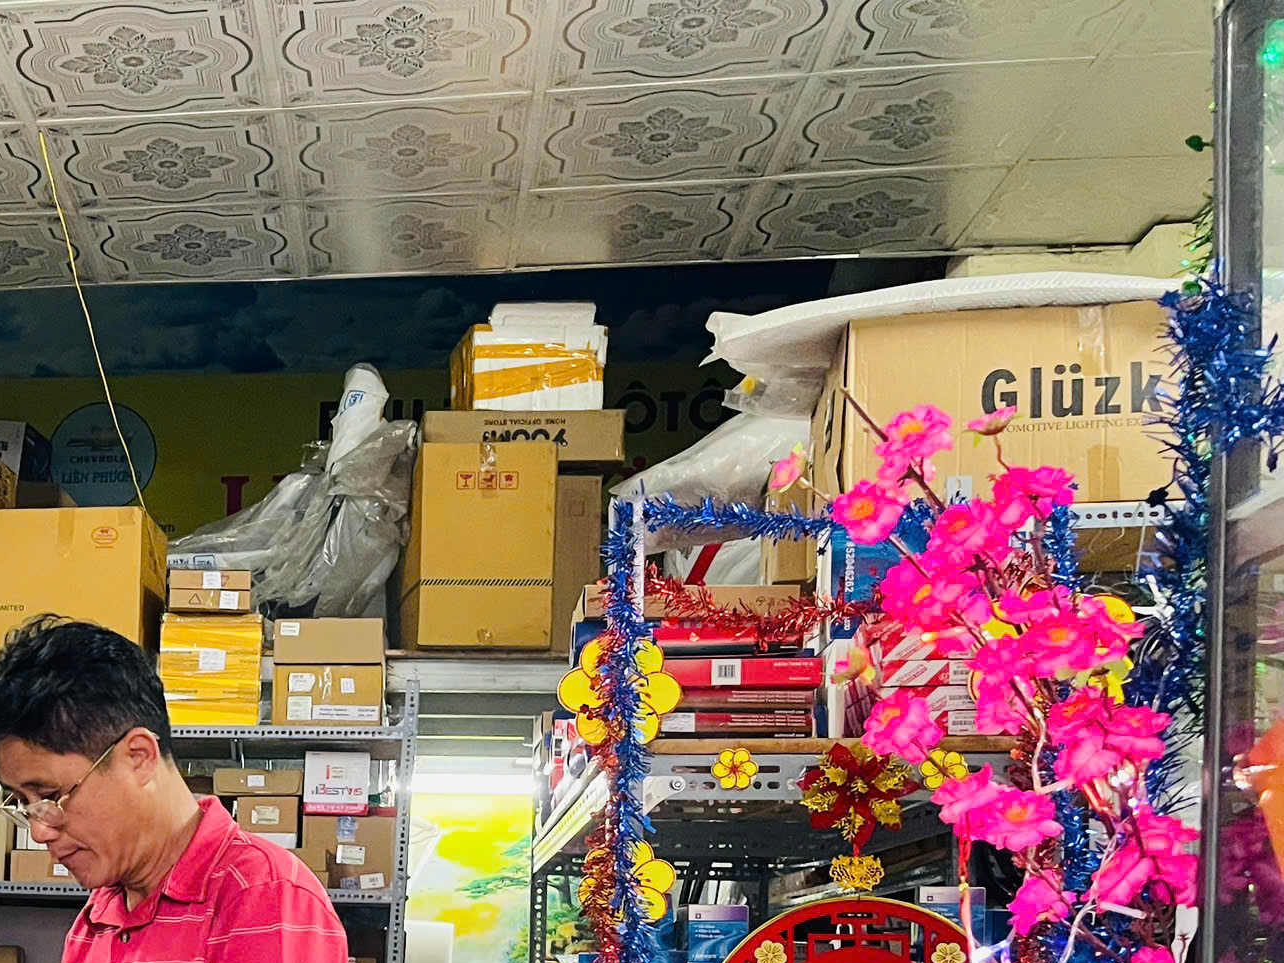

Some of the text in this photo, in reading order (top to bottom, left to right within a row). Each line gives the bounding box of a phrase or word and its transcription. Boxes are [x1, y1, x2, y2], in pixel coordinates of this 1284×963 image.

[1003, 422, 1063, 434] OMOTIVE
[1066, 418, 1122, 430] LIGHTING
[69, 455, 129, 464] CHEVROLE
